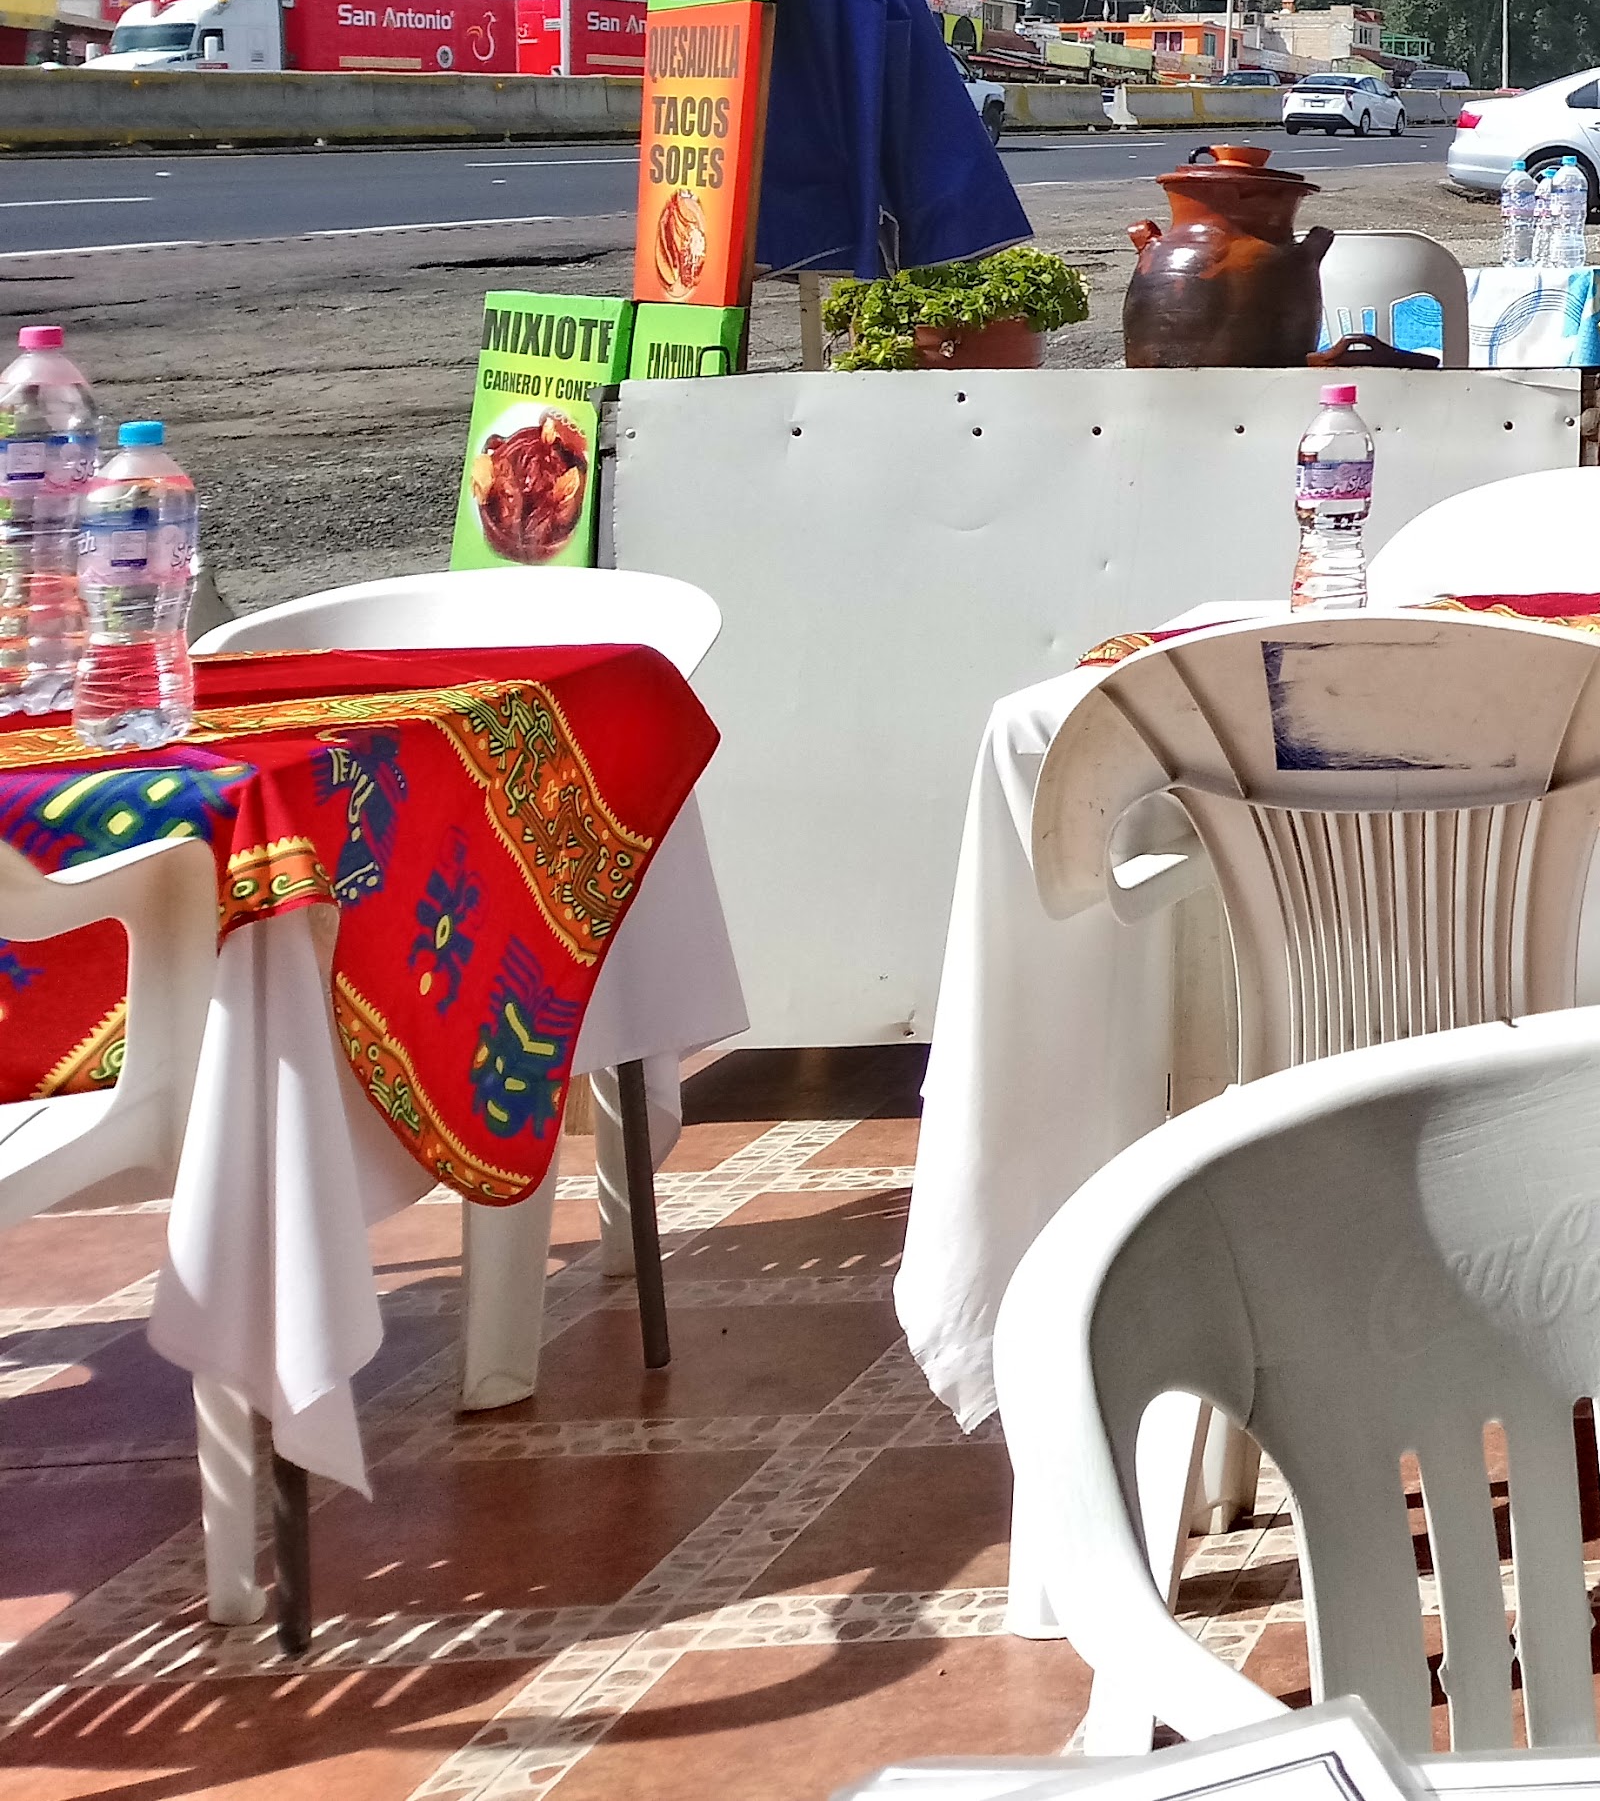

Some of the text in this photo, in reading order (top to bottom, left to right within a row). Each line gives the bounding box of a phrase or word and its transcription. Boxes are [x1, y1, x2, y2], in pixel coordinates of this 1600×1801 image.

[337, 3, 453, 31] San Antonio
[586, 10, 621, 33] San
[648, 24, 741, 84] QUESADILLA
[651, 96, 731, 139] TACOS
[649, 143, 725, 190] SOPES
[481, 308, 615, 364] MIXIOTE
[483, 368, 602, 402] CARNERO Y CONE
